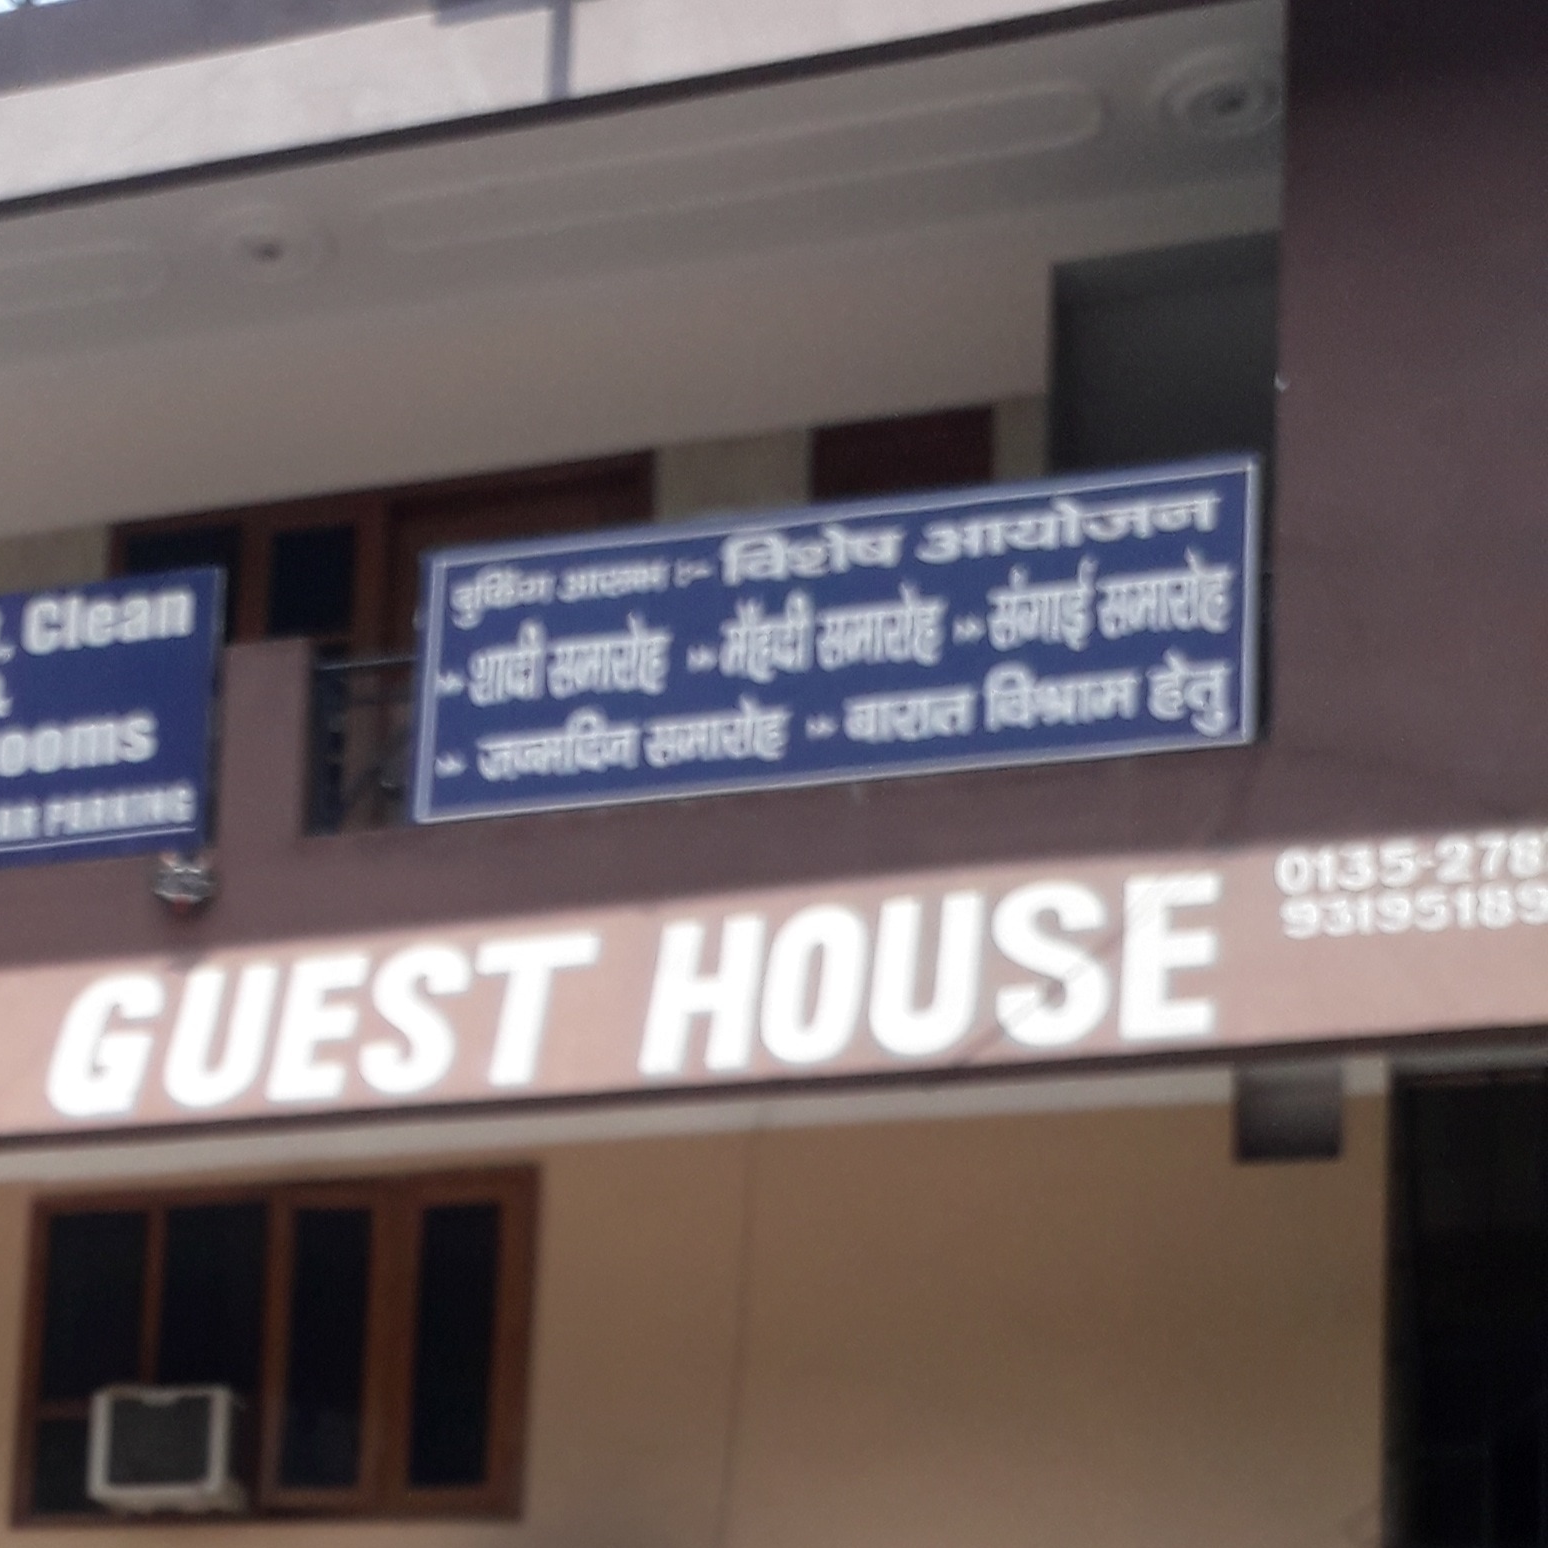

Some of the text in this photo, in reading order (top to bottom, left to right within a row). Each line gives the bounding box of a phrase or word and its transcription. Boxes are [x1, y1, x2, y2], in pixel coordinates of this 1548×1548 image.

[20, 588, 198, 656] Clean
[1273, 829, 1548, 896] 0135-278
[45, 932, 601, 1119] GUEST
[637, 868, 1222, 1077] HOUSE
